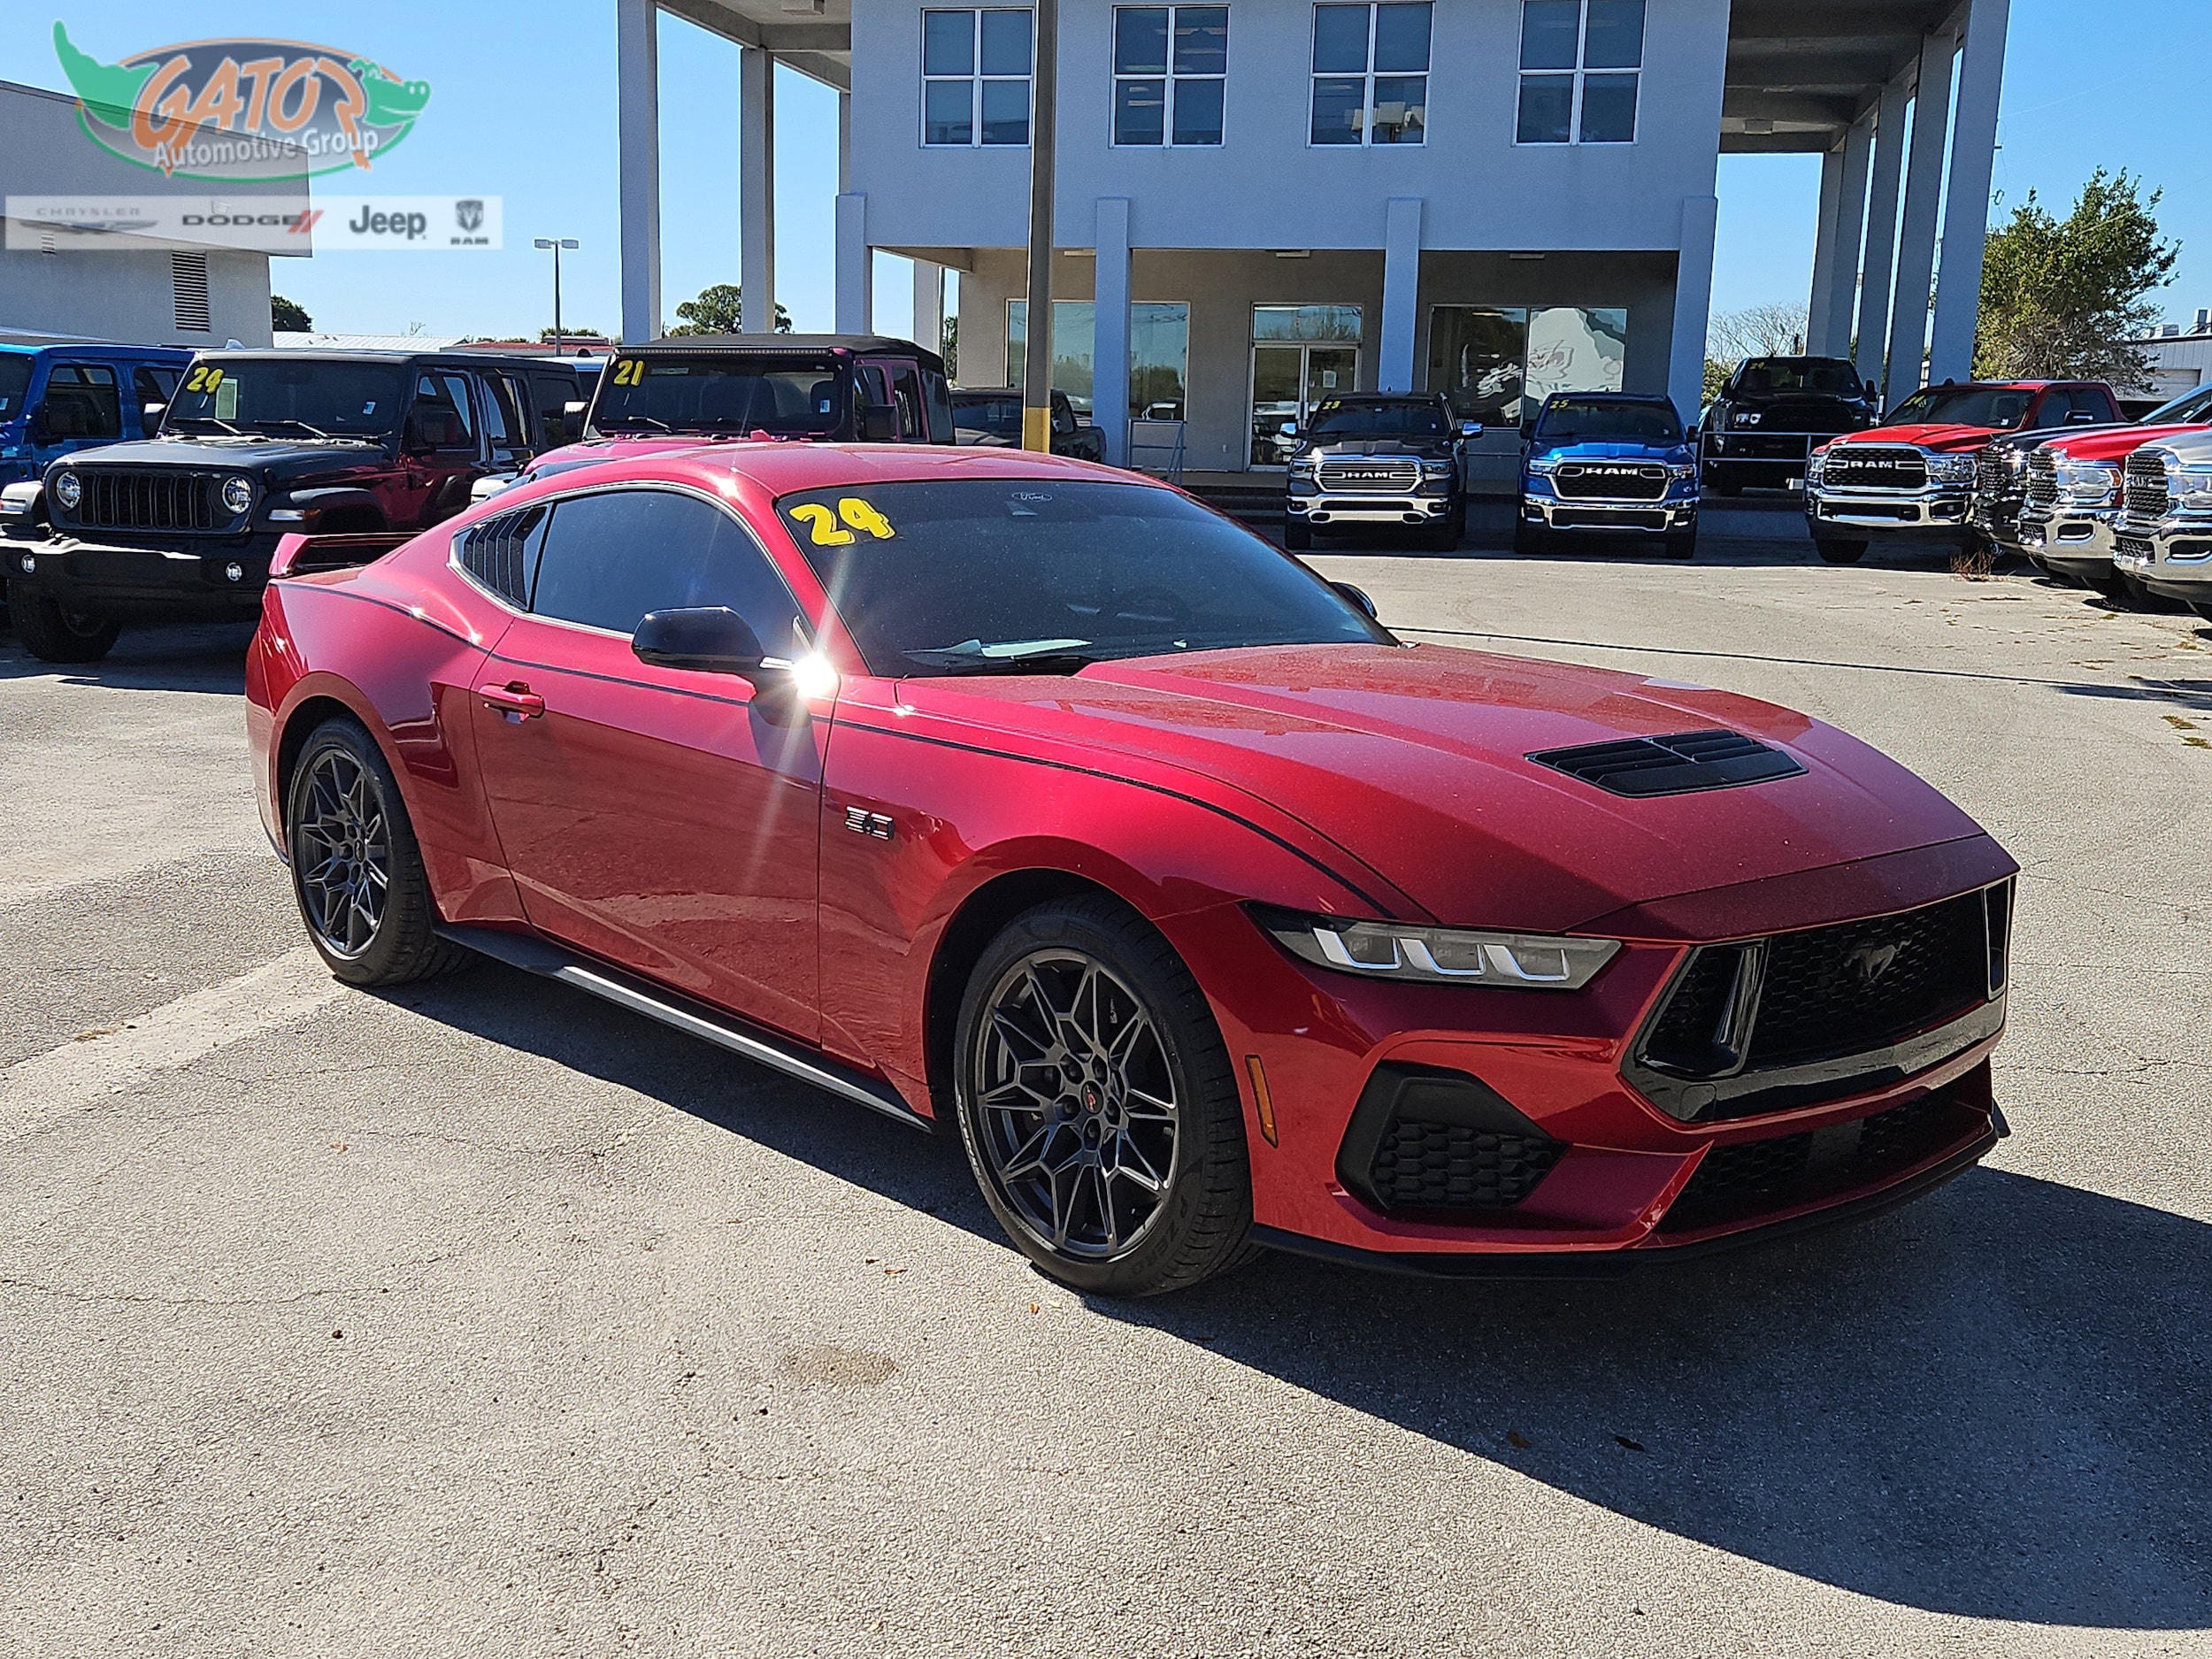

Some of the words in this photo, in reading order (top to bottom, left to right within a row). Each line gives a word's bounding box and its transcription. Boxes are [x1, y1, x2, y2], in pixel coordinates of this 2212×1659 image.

[187, 366, 224, 394] 24
[614, 359, 645, 387] 21
[1586, 467, 1639, 476] RAM
[1850, 460, 1893, 469] RAM
[788, 497, 896, 547] 24
